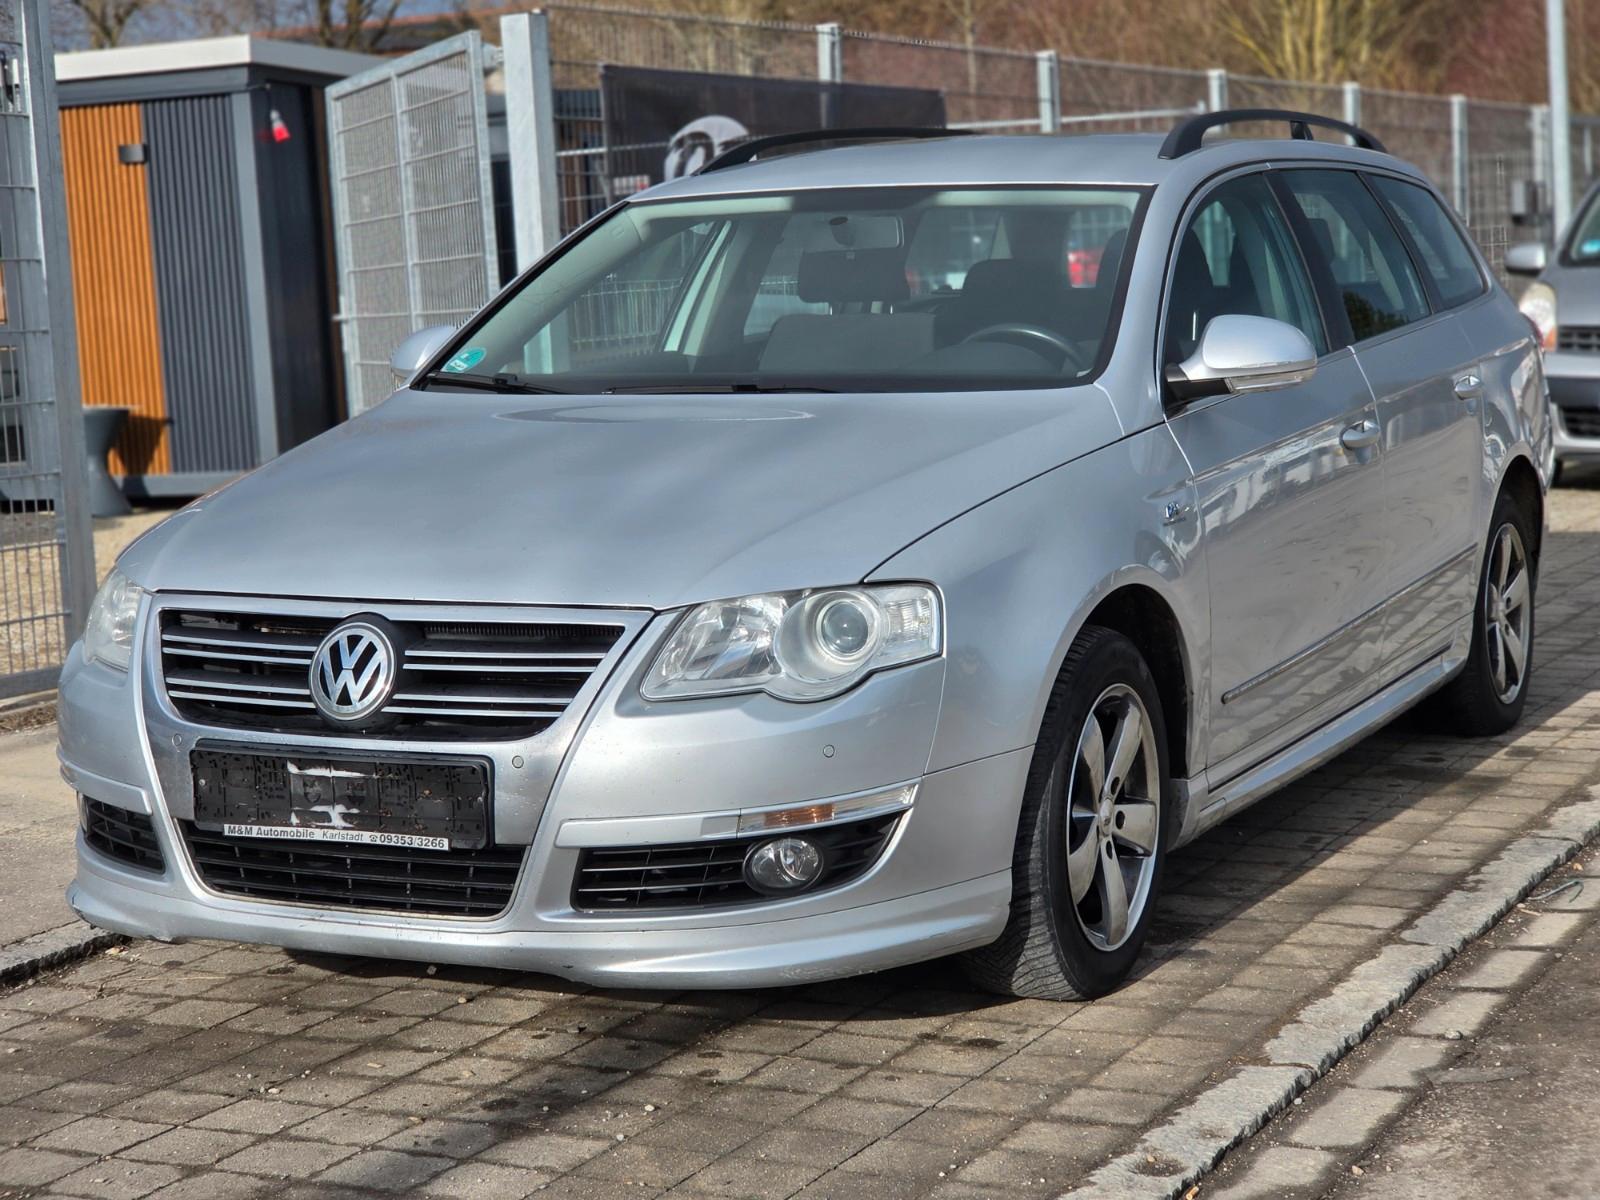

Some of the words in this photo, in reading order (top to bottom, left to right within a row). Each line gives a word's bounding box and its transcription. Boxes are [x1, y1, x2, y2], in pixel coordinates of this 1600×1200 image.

[317, 628, 388, 713] VW
[227, 825, 253, 836] M&M
[256, 826, 315, 839] Automobile
[322, 829, 364, 842] Karlstadt
[379, 833, 445, 849] 09353/3266
